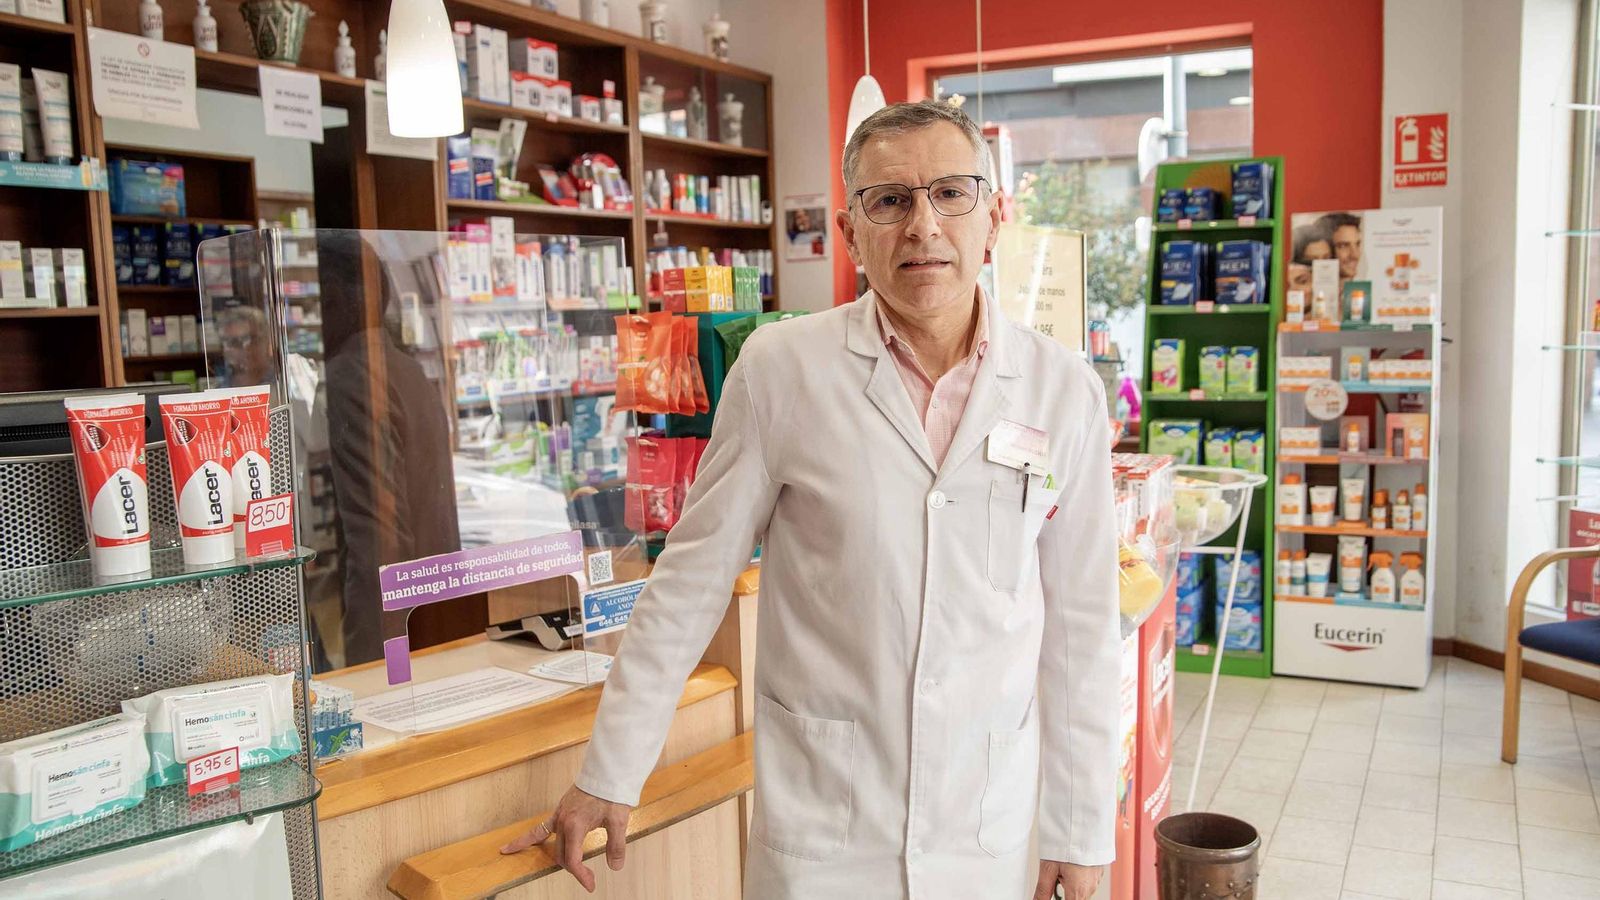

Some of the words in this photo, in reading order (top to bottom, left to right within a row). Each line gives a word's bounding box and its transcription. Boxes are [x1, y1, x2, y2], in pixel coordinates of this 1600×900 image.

[1395, 171, 1446, 185] EXTINTOR
[173, 403, 197, 412] FORMATO
[198, 402, 220, 411] AHORRO
[240, 396, 260, 404] AHORRO
[247, 457, 262, 500] acer
[119, 475, 139, 534] Lacer
[205, 468, 223, 525] Lacer
[396, 571, 409, 581] La
[411, 564, 439, 579] salud
[441, 564, 453, 573] es
[455, 547, 529, 570] responsabilidad
[531, 545, 543, 556] de
[544, 541, 571, 553] todos,
[383, 580, 447, 602] mantenga
[449, 576, 460, 588] la
[462, 565, 515, 586] distancia
[516, 562, 530, 573] de
[532, 550, 583, 572] seguridad
[614, 614, 629, 623] 645
[1315, 622, 1383, 645] Eucerin
[185, 713, 224, 727] Hemosán
[48, 766, 88, 784] Hemosán
[194, 756, 221, 776] 5,95
[224, 756, 232, 766] €
